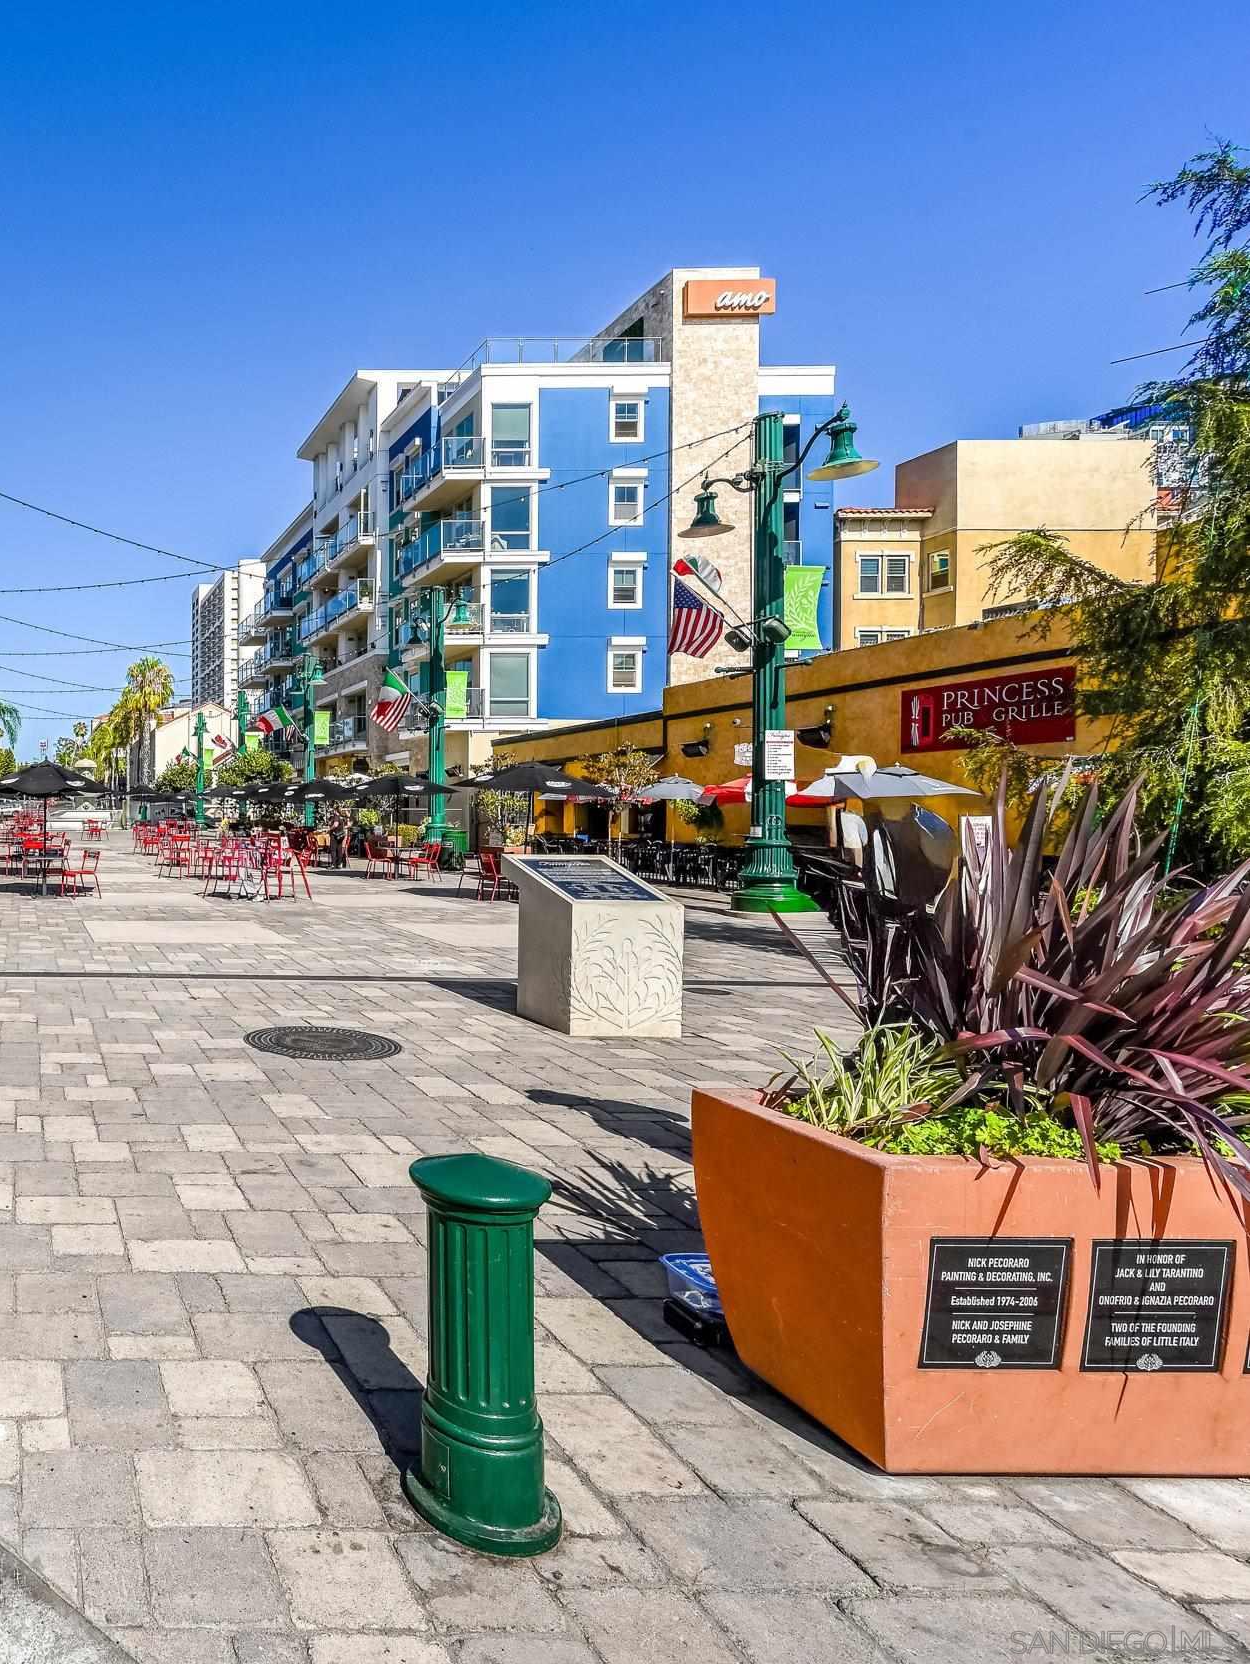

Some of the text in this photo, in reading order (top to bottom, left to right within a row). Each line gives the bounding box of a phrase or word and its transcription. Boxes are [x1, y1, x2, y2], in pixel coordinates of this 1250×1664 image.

[715, 291, 770, 311] amo
[942, 677, 1065, 711] PRINCESS
[941, 700, 1065, 727] PUB GRILLE
[968, 1258, 1030, 1269] NICK PECORARO
[1136, 1254, 1187, 1265] IN HONOR OF
[941, 1271, 977, 1282] PAINTING
[978, 1272, 984, 1282] &
[1037, 1272, 1053, 1282] INC.
[1115, 1268, 1204, 1279] JACK & LILY TARANTINO
[1149, 1281, 1166, 1292] AND
[950, 1296, 995, 1306] Established
[1099, 1295, 1215, 1306] ONOFRIO & IGNAZIA PECORARO
[952, 1320, 1033, 1331] NICK AND JOSEPHINE
[1111, 1323, 1197, 1333] TWO OF THE FOUNDING
[951, 1334, 1030, 1345] PECORARO & FAMILY
[1104, 1336, 1200, 1347] FAMILIES OF LITTLE ITALY
